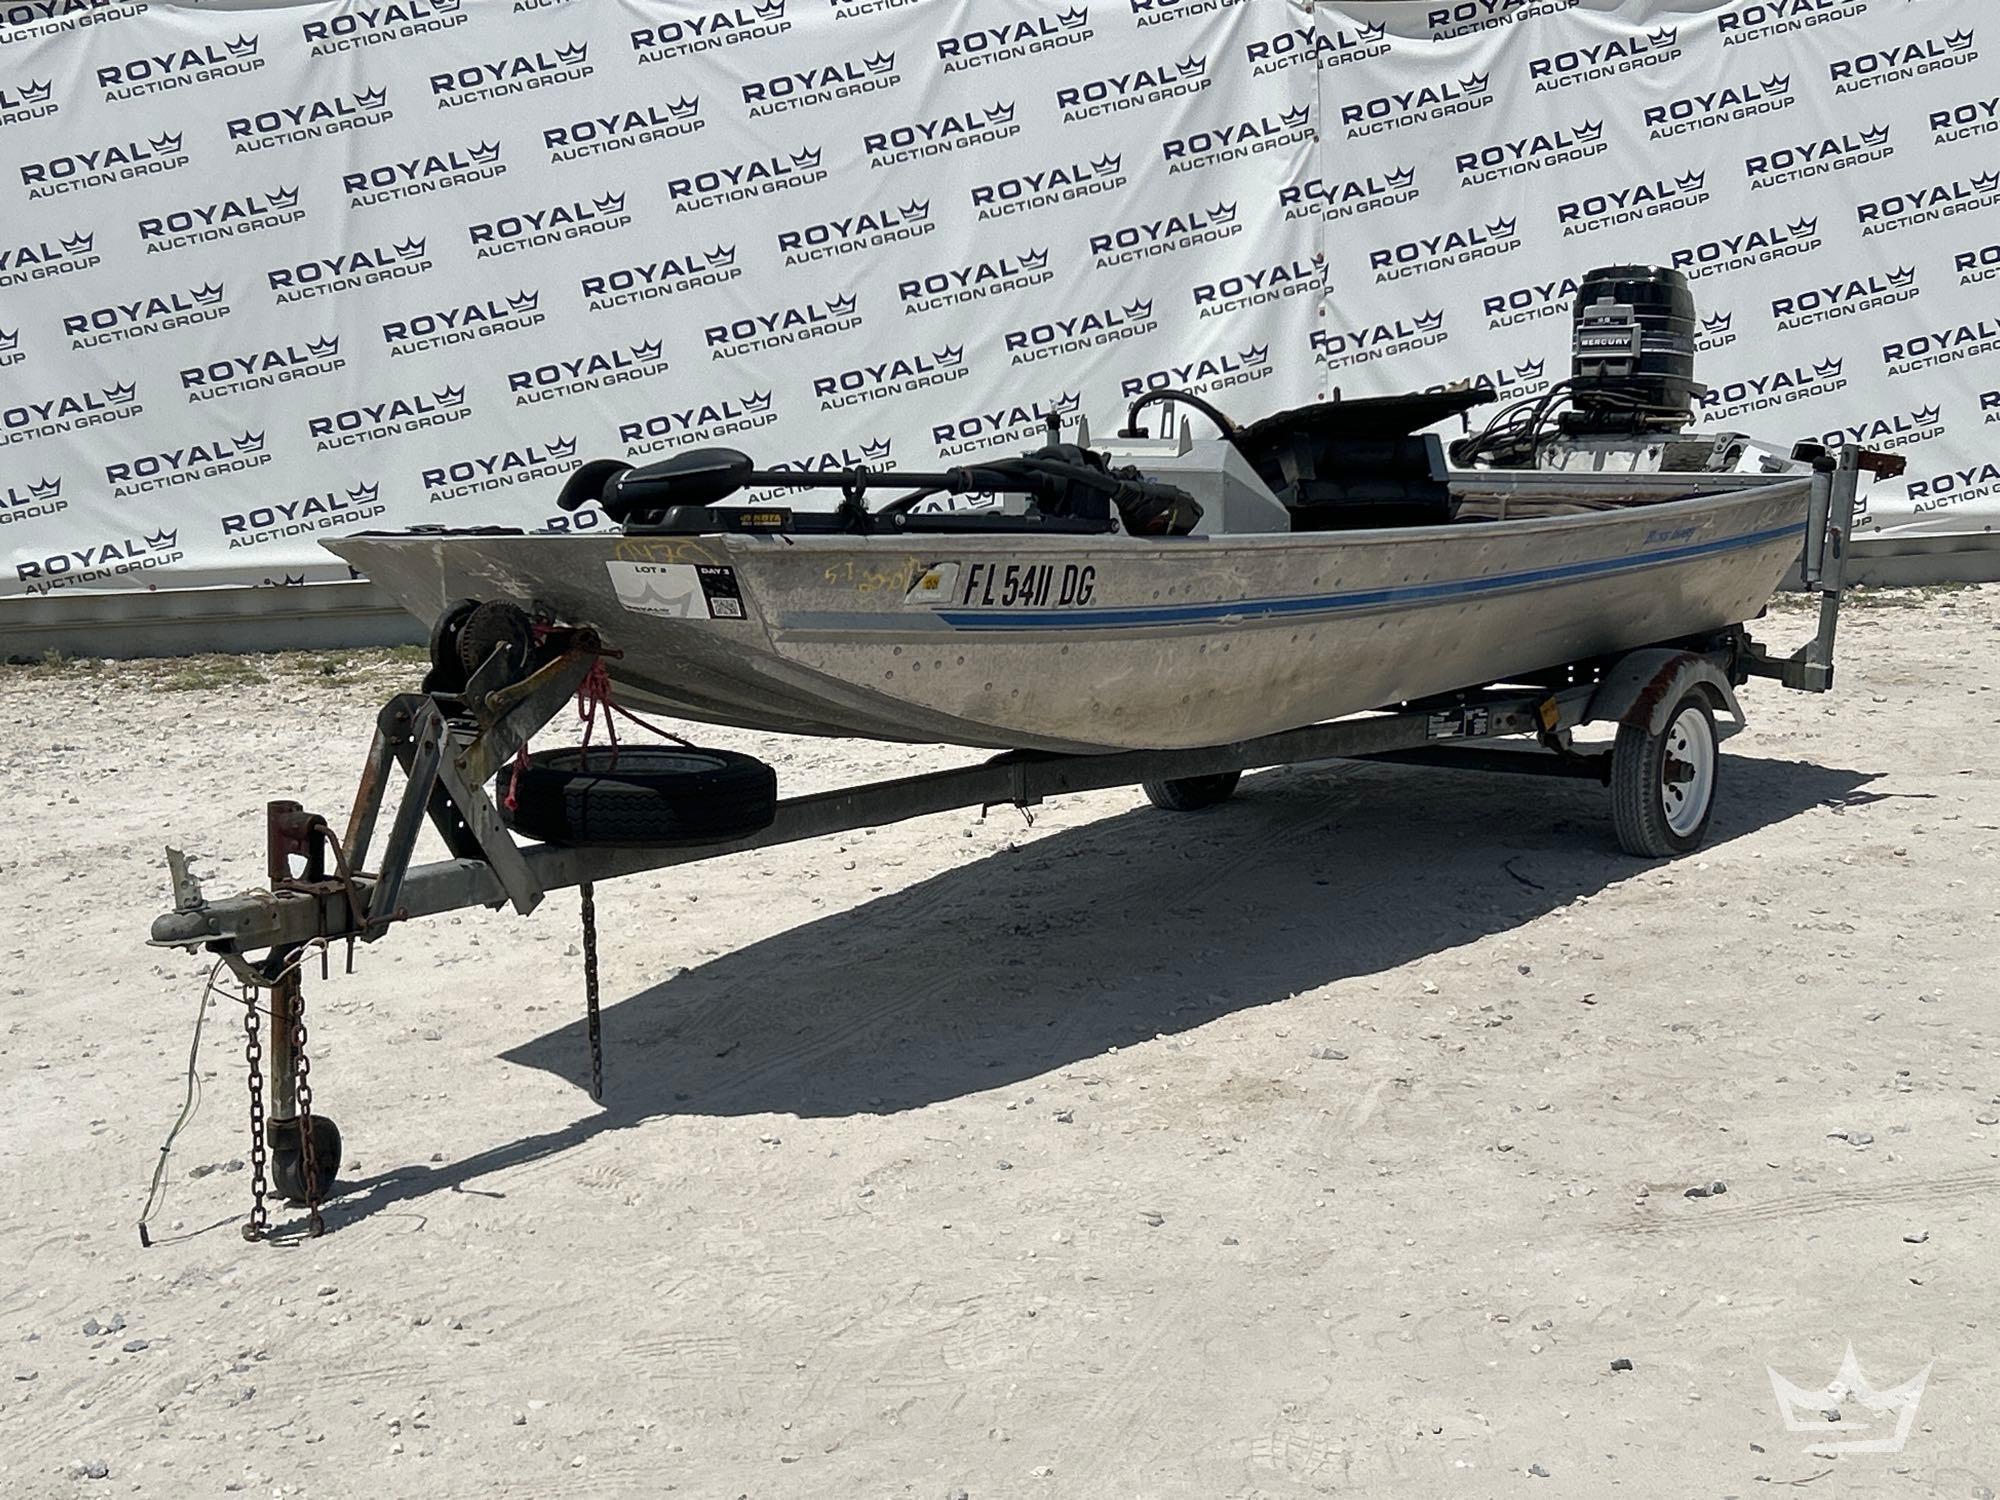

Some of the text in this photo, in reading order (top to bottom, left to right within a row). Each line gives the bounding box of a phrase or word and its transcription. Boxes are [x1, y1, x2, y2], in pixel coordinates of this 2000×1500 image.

[303, 0, 431, 42] ROYAL
[311, 14, 468, 57] AUCTION GROUP
[631, 9, 755, 50] ROYAL
[937, 17, 1059, 59] ROYAL
[1723, 4, 1867, 47] AUCTION GROUP
[639, 22, 791, 65] AUCTION GROUP
[944, 30, 1094, 74] AUCTION GROUP
[1529, 37, 1649, 79] ROYAL
[1830, 40, 1945, 81] ROYAL
[97, 45, 227, 88] ROYAL
[106, 59, 265, 103] AUCTION GROUP
[430, 53, 557, 95] ROYAL
[438, 66, 593, 110] AUCTION GROUP
[742, 62, 865, 103] ROYAL
[1056, 66, 1177, 109] ROYAL
[1535, 48, 1681, 93] AUCTION GROUP
[1835, 52, 1978, 95] AUCTION GROUP
[227, 98, 356, 139] ROYAL
[749, 75, 900, 119] AUCTION GROUP
[1064, 78, 1211, 123] AUCTION GROUP
[1341, 83, 1461, 125] ROYAL
[1347, 95, 1493, 140] AUCTION GROUP
[1644, 84, 1761, 127] ROYAL
[235, 111, 393, 154] AUCTION GROUP
[543, 107, 669, 149] ROYAL
[864, 112, 985, 154] ROYAL
[1163, 118, 1281, 161] ROYAL
[1650, 97, 1795, 141] AUCTION GROUP
[551, 120, 705, 164] AUCTION GROUP
[871, 125, 1020, 169] AUCTION GROUP
[1169, 129, 1316, 175] AUCTION GROUP
[1456, 131, 1573, 173] ROYAL
[1746, 135, 1861, 176] ROYAL
[20, 143, 151, 185] ROYAL
[29, 156, 189, 200] AUCTION GROUP
[343, 152, 470, 194] ROYAL
[668, 157, 792, 200] ROYAL
[971, 164, 1092, 207] ROYAL
[1461, 143, 1607, 187] AUCTION GROUP
[1751, 147, 1894, 190] AUCTION GROUP
[351, 165, 506, 209] AUCTION GROUP
[676, 170, 827, 214] AUCTION GROUP
[978, 177, 1127, 221] AUCTION GROUP
[1558, 181, 1676, 223] ROYAL
[1857, 182, 1971, 223] ROYAL
[138, 197, 268, 239] ROYAL
[147, 210, 305, 254] AUCTION GROUP
[469, 203, 595, 244] ROYAL
[778, 210, 900, 252] ROYAL
[1090, 212, 1207, 255] ROYAL
[1563, 193, 1709, 237] AUCTION GROUP
[1862, 209, 1939, 237] AUCTION
[477, 216, 631, 259] AUCTION GROUP
[785, 223, 935, 267] AUCTION GROUP
[1096, 224, 1242, 269] AUCTION GROUP
[1370, 228, 1487, 270] ROYAL
[1671, 227, 1788, 270] ROYAL
[1759, 239, 1821, 262] GROUP
[268, 248, 396, 290] ROYAL
[276, 261, 432, 305] AUCTION GROUP
[581, 256, 706, 297] ROYAL
[899, 259, 1019, 301] ROYAL
[1376, 239, 1521, 284] AUCTION GROUP
[590, 268, 742, 312] AUCTION GROUP
[905, 271, 1054, 315] AUCTION GROUP
[1772, 276, 1887, 318] ROYAL
[1777, 288, 1919, 331] AUCTION GROUP
[63, 294, 192, 335] ROYAL
[72, 307, 230, 350] AUCTION GROUP
[383, 301, 509, 343] ROYAL
[391, 314, 545, 357] AUCTION GROUP
[704, 305, 827, 346] ROYAL
[1005, 310, 1124, 352] ROYAL
[712, 317, 862, 361] AUCTION GROUP
[1012, 321, 1157, 366] AUCTION GROUP
[1581, 338, 1630, 346] MERCURY
[180, 347, 309, 389] ROYAL
[189, 359, 345, 403] AUCTION GROUP
[508, 350, 633, 392] ROYAL
[516, 363, 668, 406] AUCTION GROUP
[813, 356, 934, 397] ROYAL
[821, 368, 969, 411] AUCTION GROUP
[1700, 368, 1814, 409] ROYAL
[309, 396, 435, 437] ROYAL
[619, 402, 742, 443] ROYAL
[1703, 379, 1847, 423] AUCTION GROUP
[317, 408, 472, 452] AUCTION GROUP
[627, 414, 777, 457] AUCTION GROUP
[106, 442, 234, 484] ROYAL
[115, 454, 271, 498] AUCTION GROUP
[422, 447, 547, 489] ROYAL
[430, 459, 582, 503] AUCTION GROUP
[221, 493, 349, 535] ROYAL
[229, 505, 385, 549] AUCTION GROUP
[16, 540, 146, 582] ROYAL
[26, 552, 184, 595] AUCTION GROUP
[635, 566, 657, 574] LOT
[701, 567, 721, 575] DAY
[963, 564, 996, 606] FL
[1002, 564, 1054, 606] 5411
[1058, 564, 1096, 606] DG
